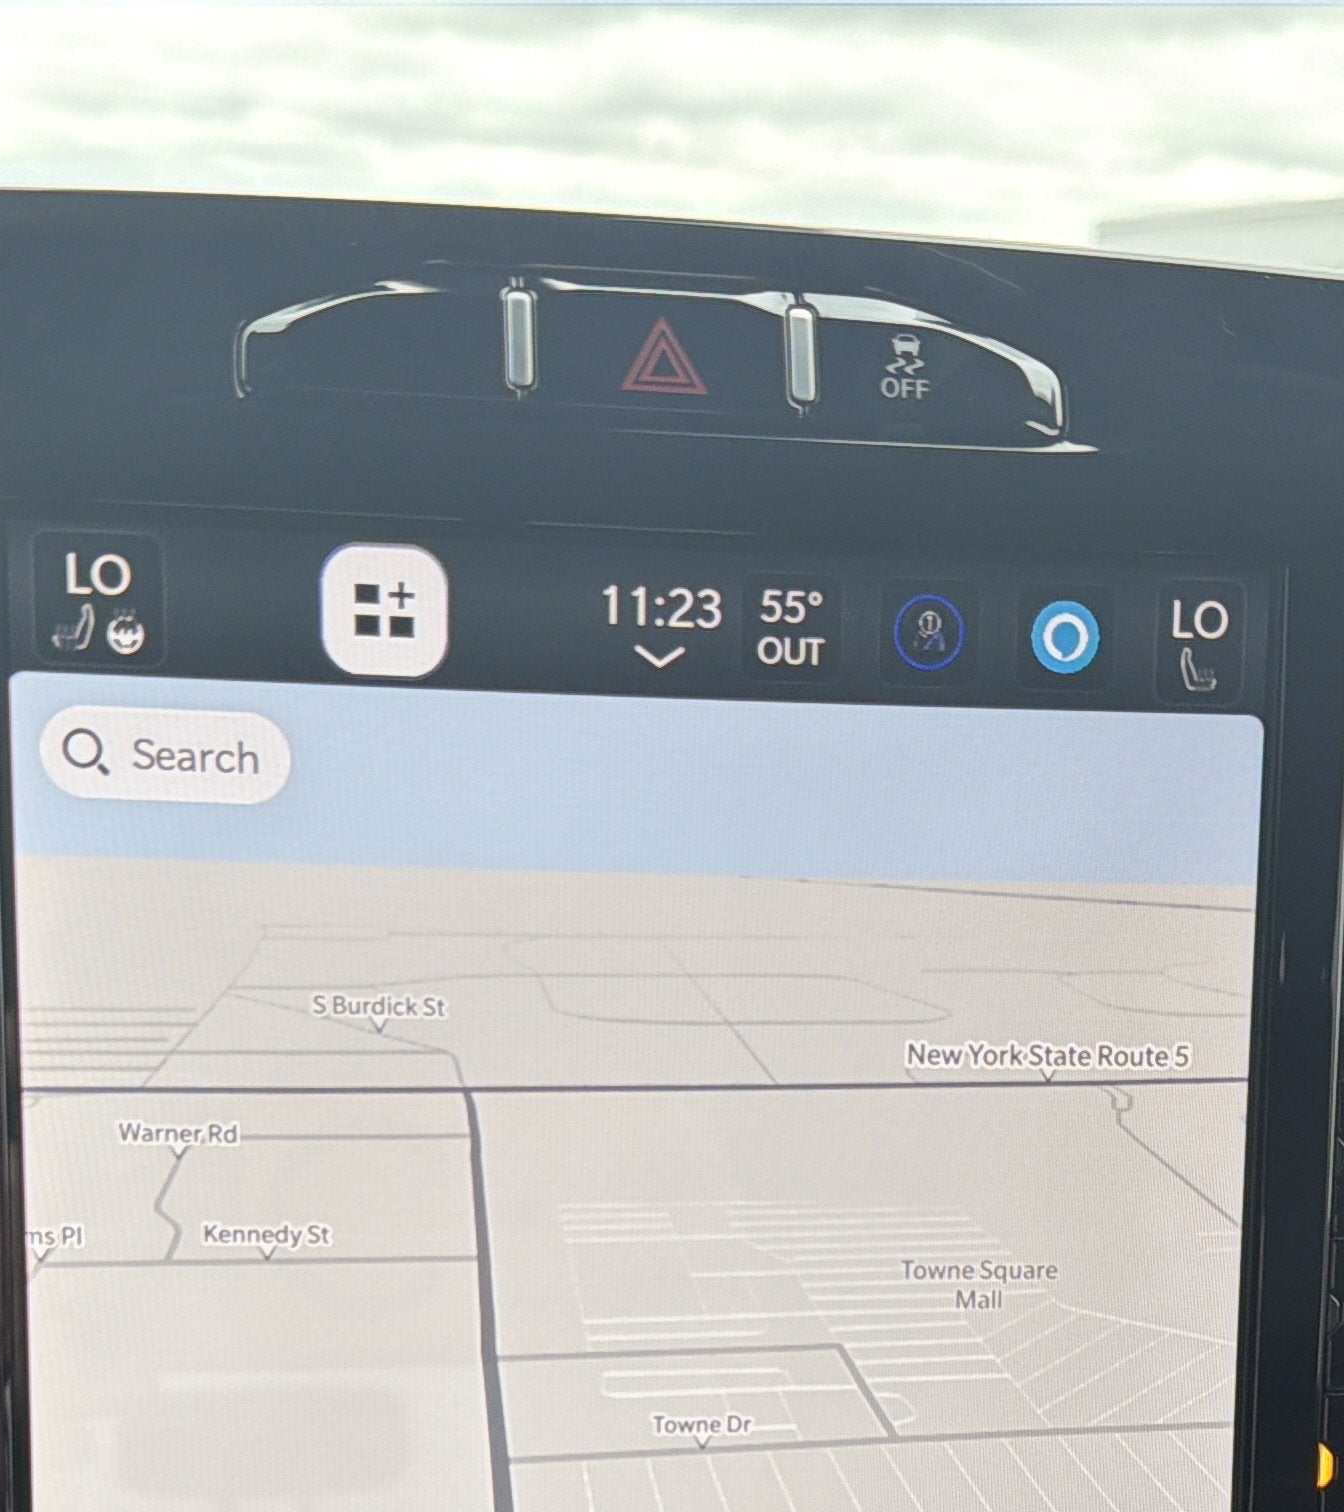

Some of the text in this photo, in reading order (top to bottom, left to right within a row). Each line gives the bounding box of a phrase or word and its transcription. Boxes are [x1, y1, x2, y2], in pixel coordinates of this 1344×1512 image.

[880, 376, 930, 400] OFF
[66, 552, 131, 596] LO
[602, 584, 722, 629] 11:23
[760, 588, 823, 624] 55°
[1172, 599, 1229, 640] LO
[757, 636, 826, 666] OUT
[132, 738, 259, 775] Search
[313, 995, 445, 1017] S Burdick St
[908, 1043, 1189, 1068] New York State Route 5
[118, 1122, 238, 1144] Warner Rd
[204, 1223, 329, 1248] Kennedy St
[900, 1259, 1059, 1284] Towne Square
[955, 1289, 1002, 1310] Mall
[653, 1414, 752, 1434] Towne Dr
